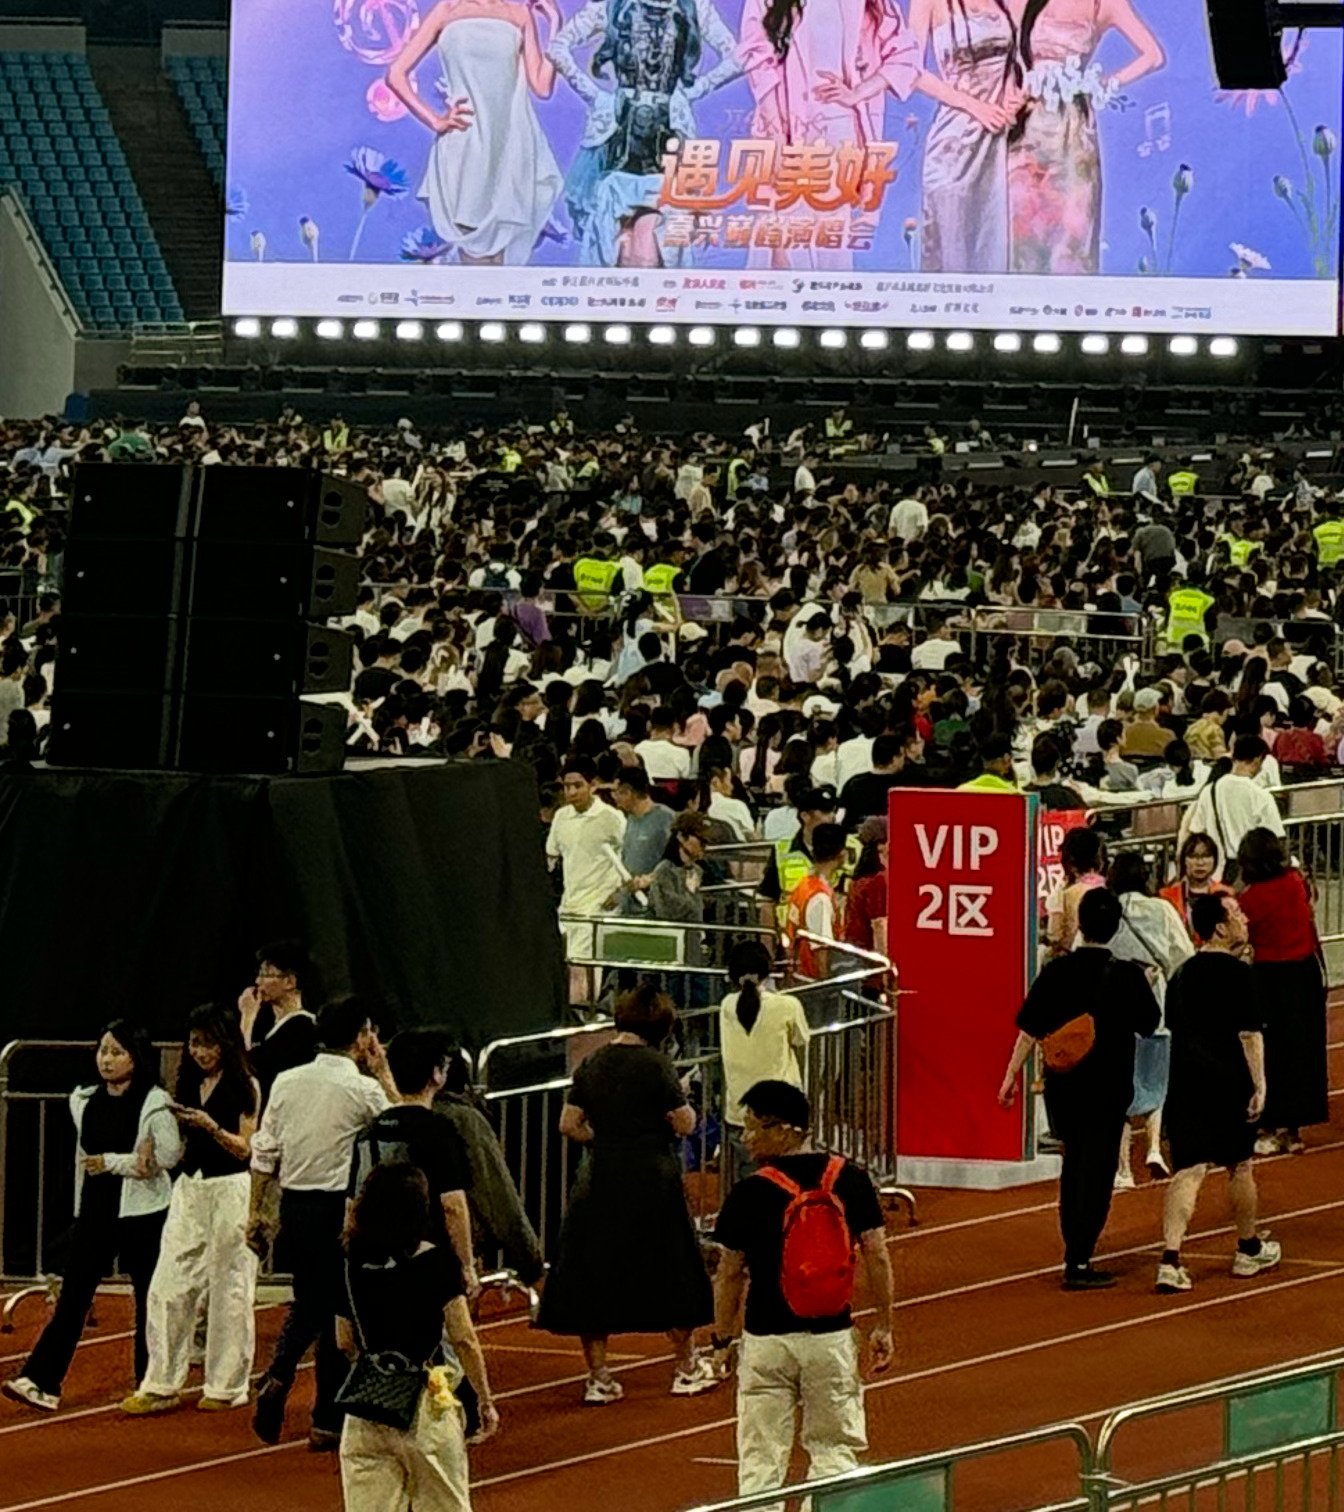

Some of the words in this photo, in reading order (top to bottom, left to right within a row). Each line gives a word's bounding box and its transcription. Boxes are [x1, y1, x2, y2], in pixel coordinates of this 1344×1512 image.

[658, 138, 898, 212] 遇见美好
[913, 823, 999, 871] VIP
[1037, 824, 1065, 856] IP
[916, 884, 994, 937] 2区
